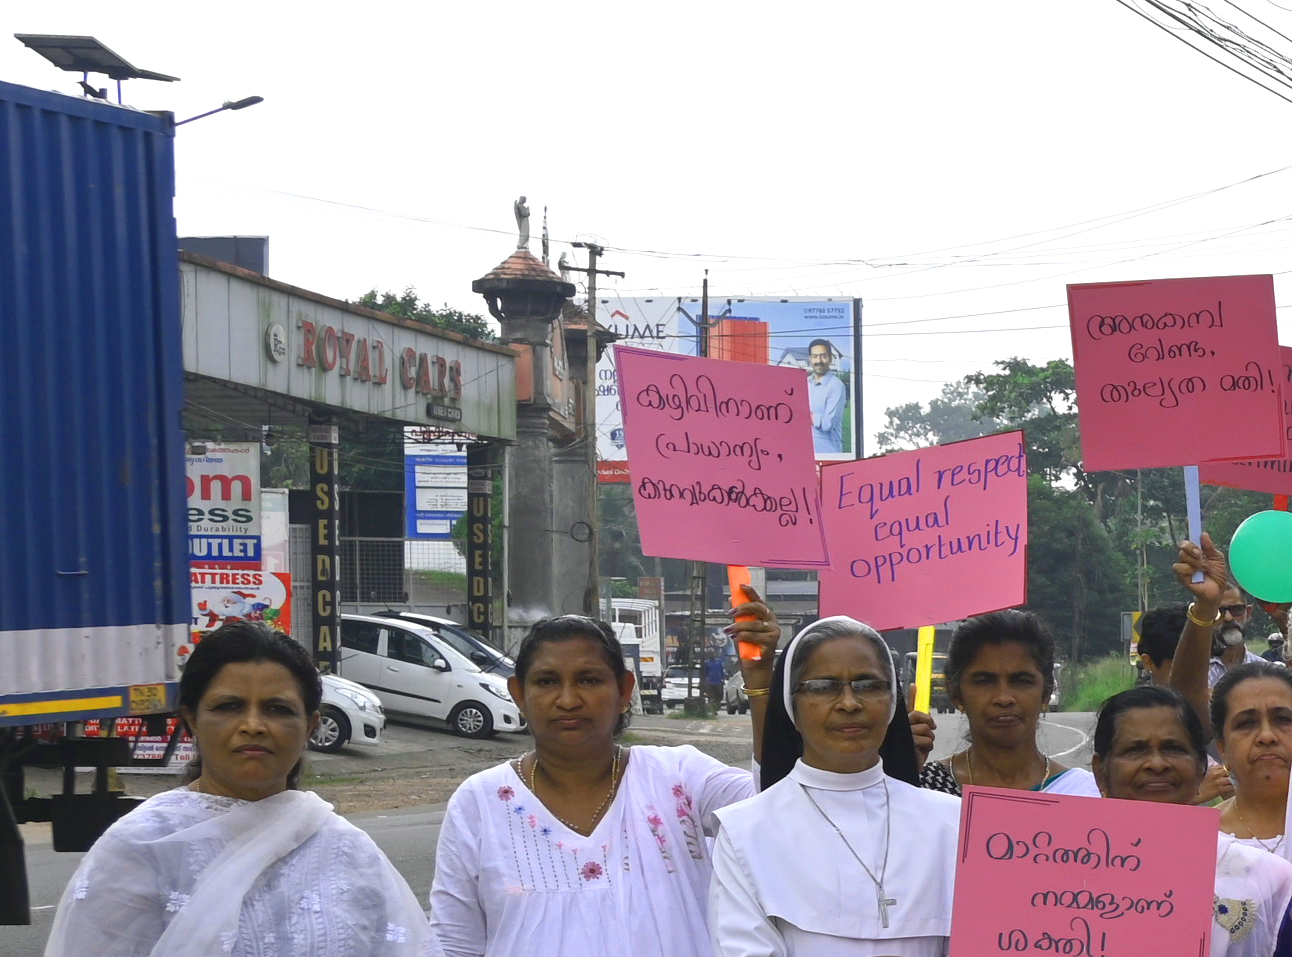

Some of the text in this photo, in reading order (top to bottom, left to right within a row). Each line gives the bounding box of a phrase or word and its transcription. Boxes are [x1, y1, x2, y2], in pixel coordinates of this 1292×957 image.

[297, 319, 462, 401] ROYAL CARS
[636, 373, 794, 424] കഴിവിനാണ്
[1100, 373, 1206, 409] തുല്യത
[838, 442, 1026, 520] Equal respect
[189, 538, 257, 557] UTLET
[196, 524, 249, 534] Durability
[874, 495, 951, 549] equal
[850, 519, 1020, 584] opportunity
[1030, 889, 1175, 920] നമ്മളാണ്
